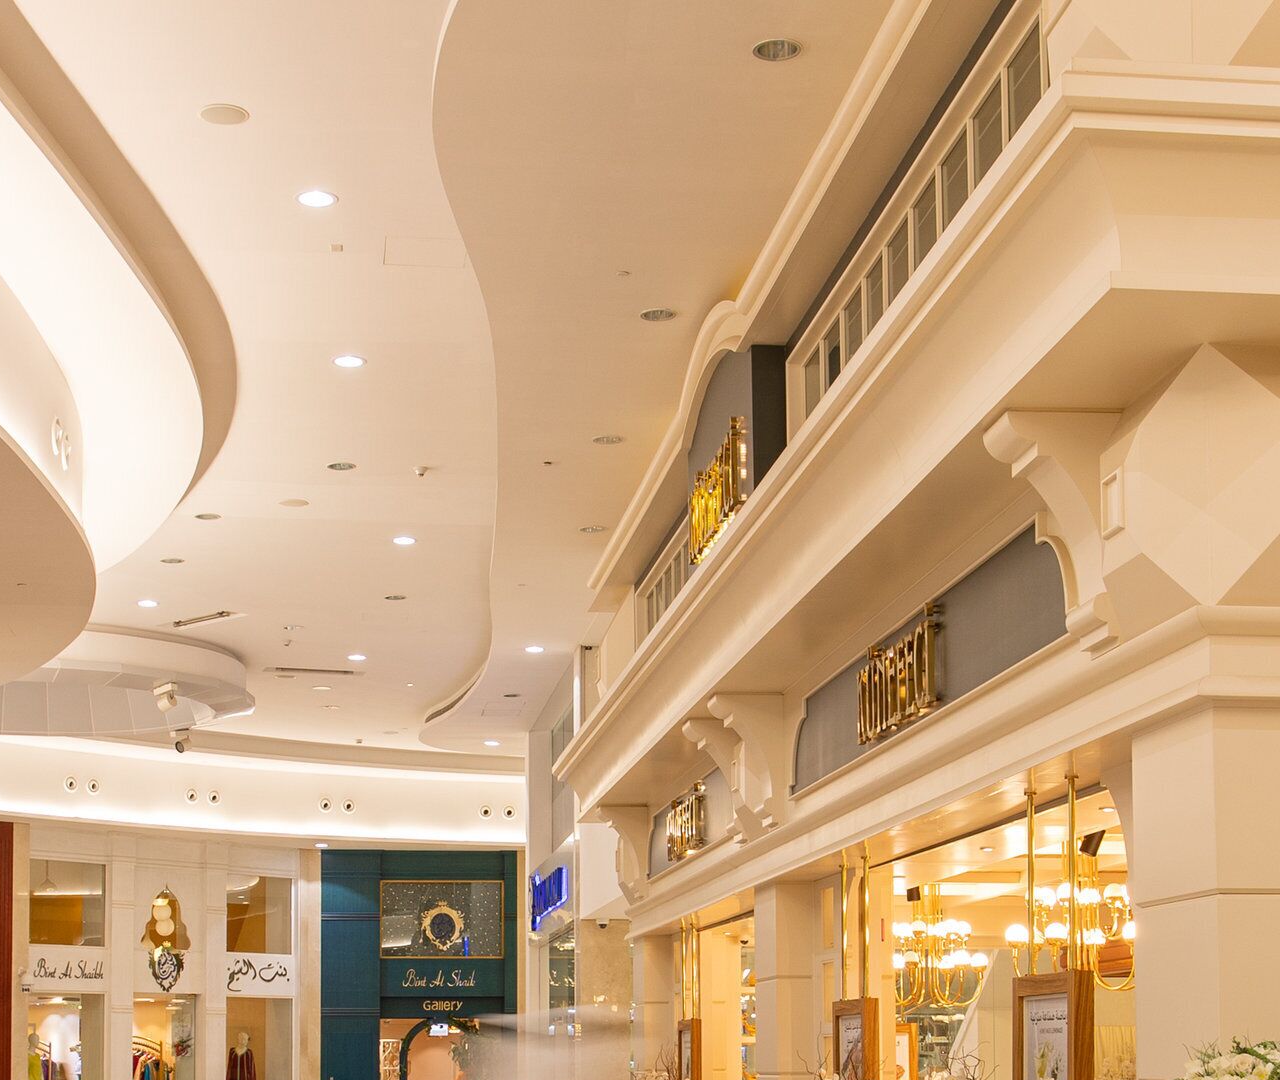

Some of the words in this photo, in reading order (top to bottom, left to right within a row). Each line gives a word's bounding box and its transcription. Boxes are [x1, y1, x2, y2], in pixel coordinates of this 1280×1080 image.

[33, 957, 57, 978] Bint
[58, 961, 72, 980] Al
[74, 959, 104, 980] Shaikh
[227, 958, 257, 992] الشيخ
[258, 961, 290, 982] بنت
[402, 968, 427, 988] Bint
[429, 969, 445, 988] Al
[422, 1000, 463, 1011] Gallery
